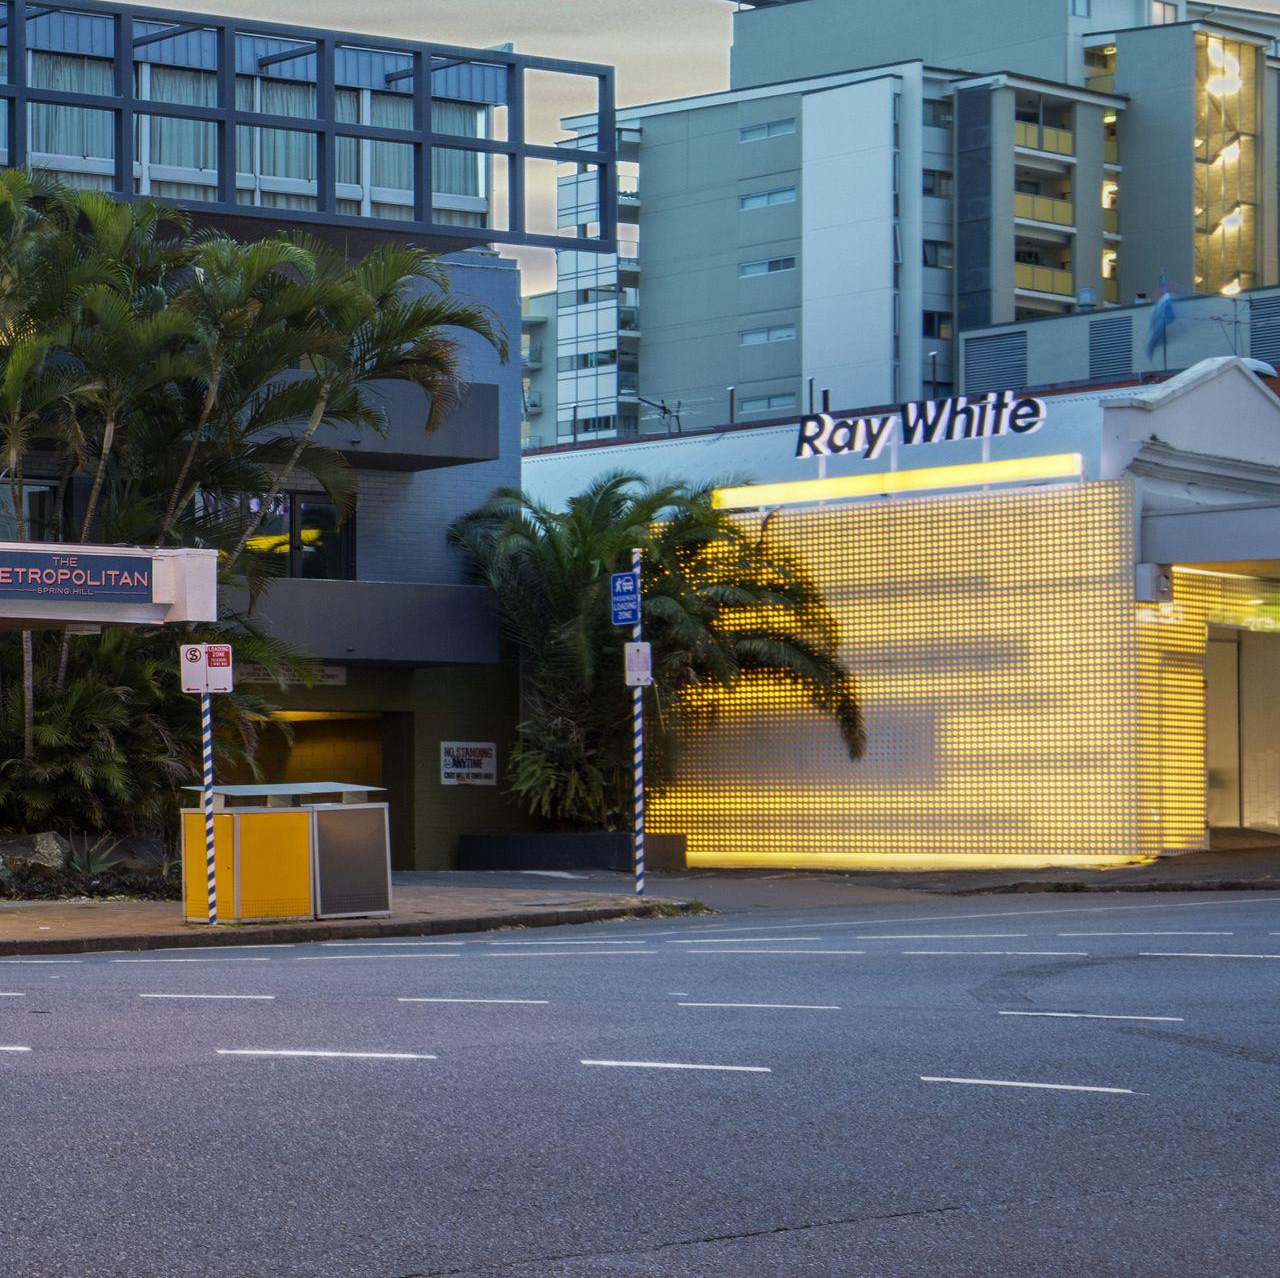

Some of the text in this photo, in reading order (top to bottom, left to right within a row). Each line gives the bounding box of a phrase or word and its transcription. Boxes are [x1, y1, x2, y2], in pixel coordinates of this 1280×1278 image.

[795, 390, 1047, 460] Ray White
[52, 556, 79, 568] THE
[36, 587, 70, 595] SPRING
[613, 602, 637, 611] LOADING
[618, 610, 633, 620] ZONE
[444, 746, 493, 758] NO STANDING
